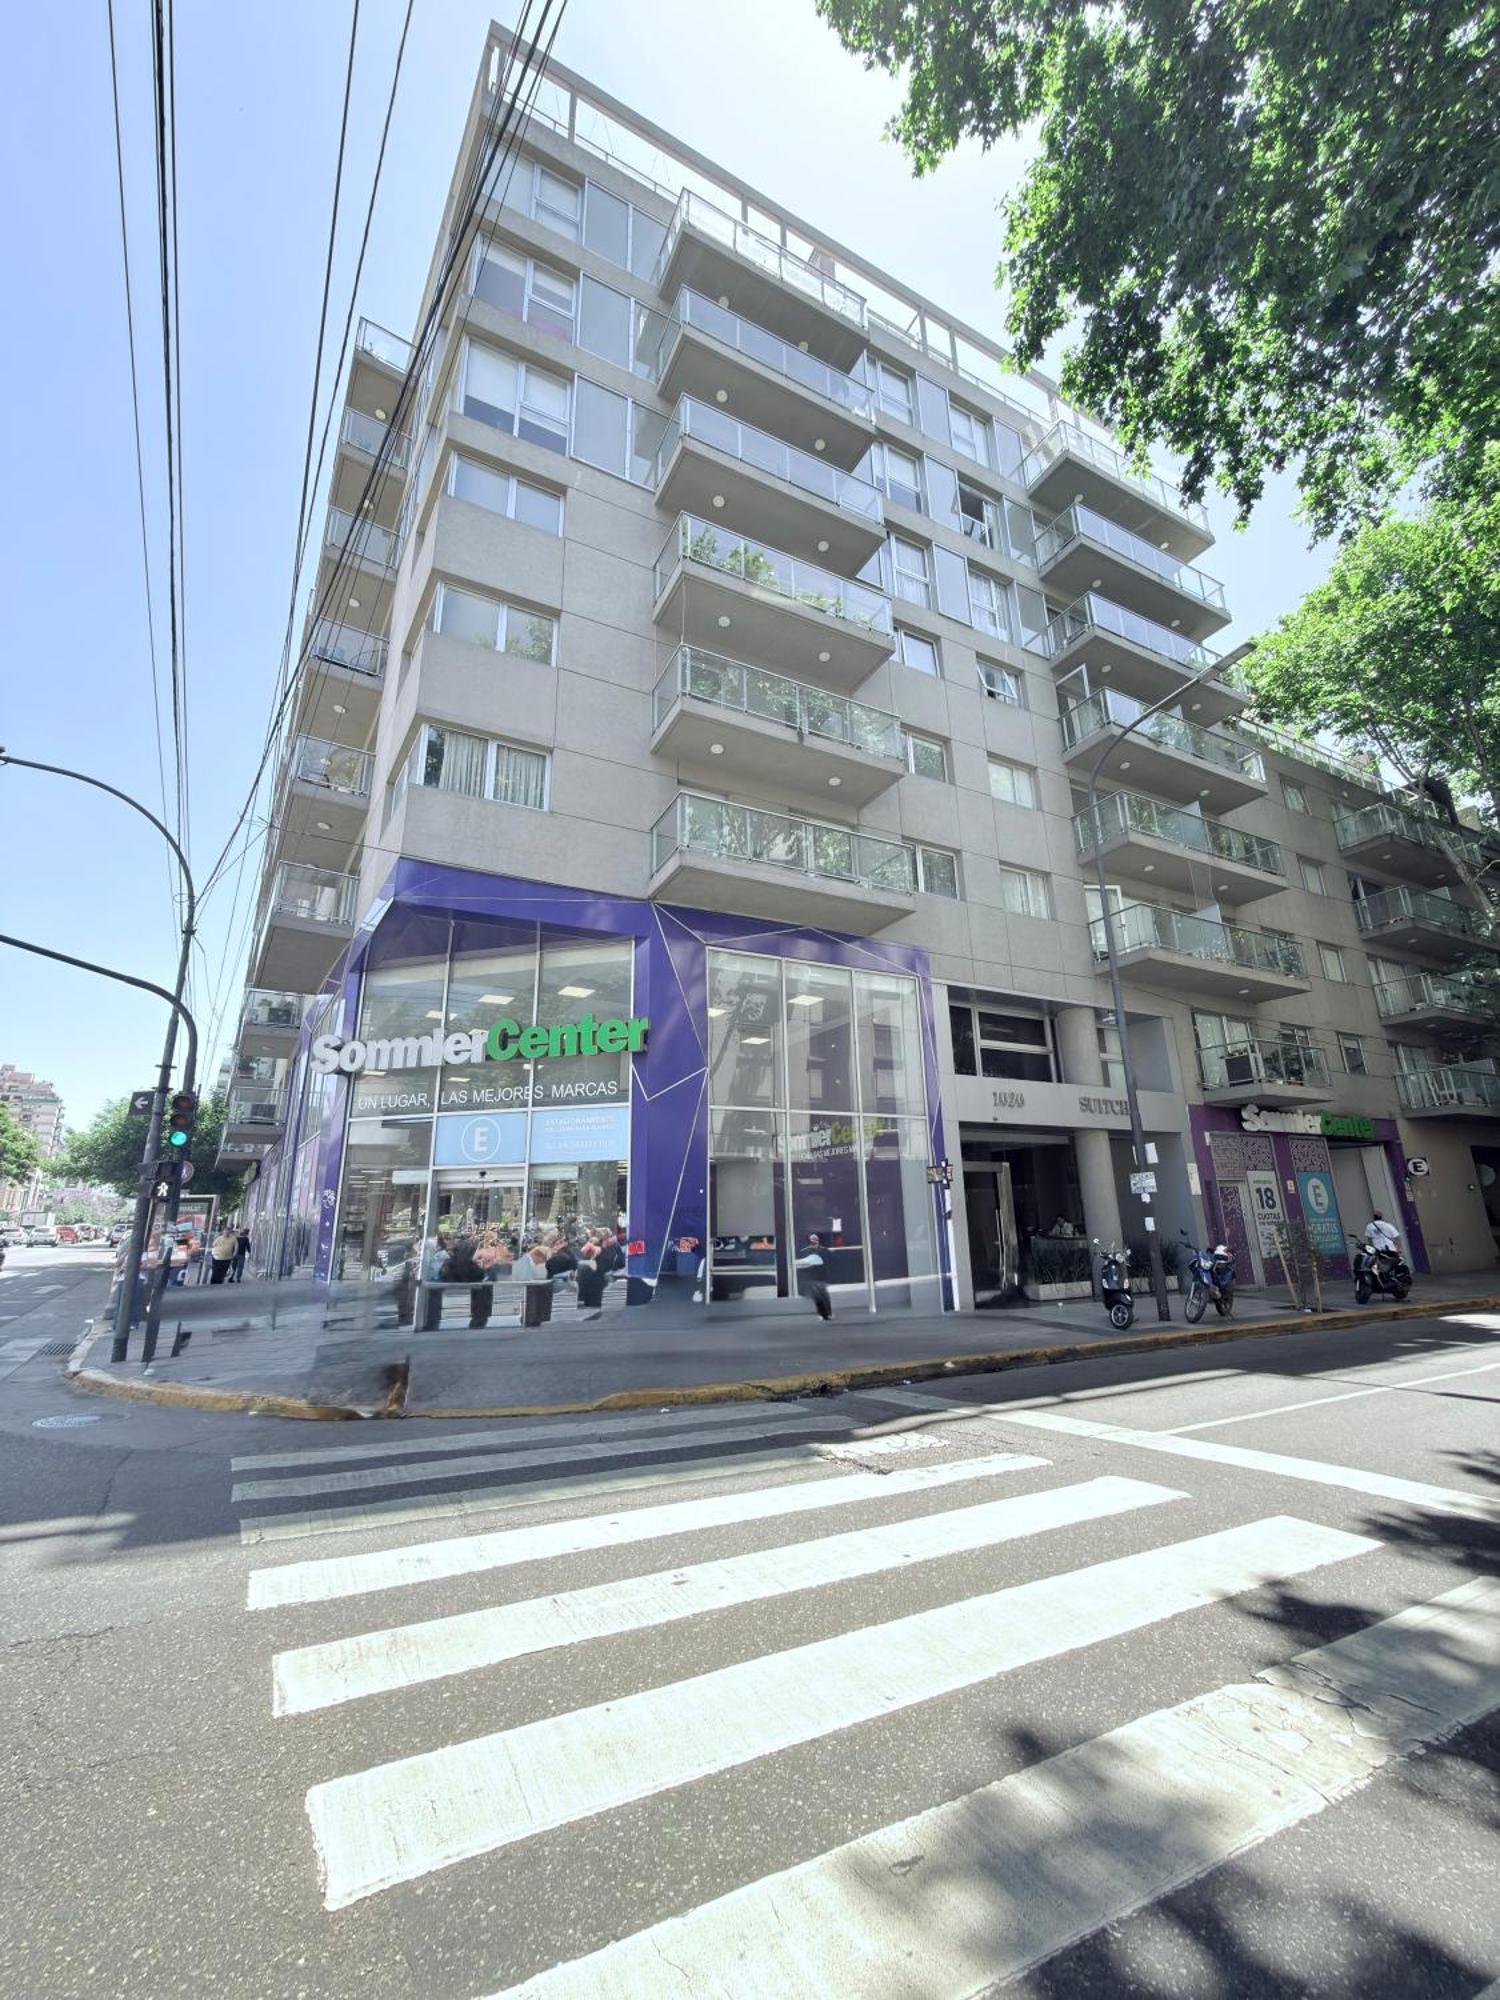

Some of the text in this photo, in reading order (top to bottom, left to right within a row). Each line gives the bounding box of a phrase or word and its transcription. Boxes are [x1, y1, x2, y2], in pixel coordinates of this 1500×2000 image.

[440, 1089, 468, 1106] LAS
[472, 1084, 544, 1104] MEJORES
[551, 1080, 618, 1099] MARCAS
[473, 1127, 489, 1152] E
[1412, 1161, 1425, 1172] E
[1255, 1187, 1276, 1209] 18
[1312, 1184, 1324, 1207] E
